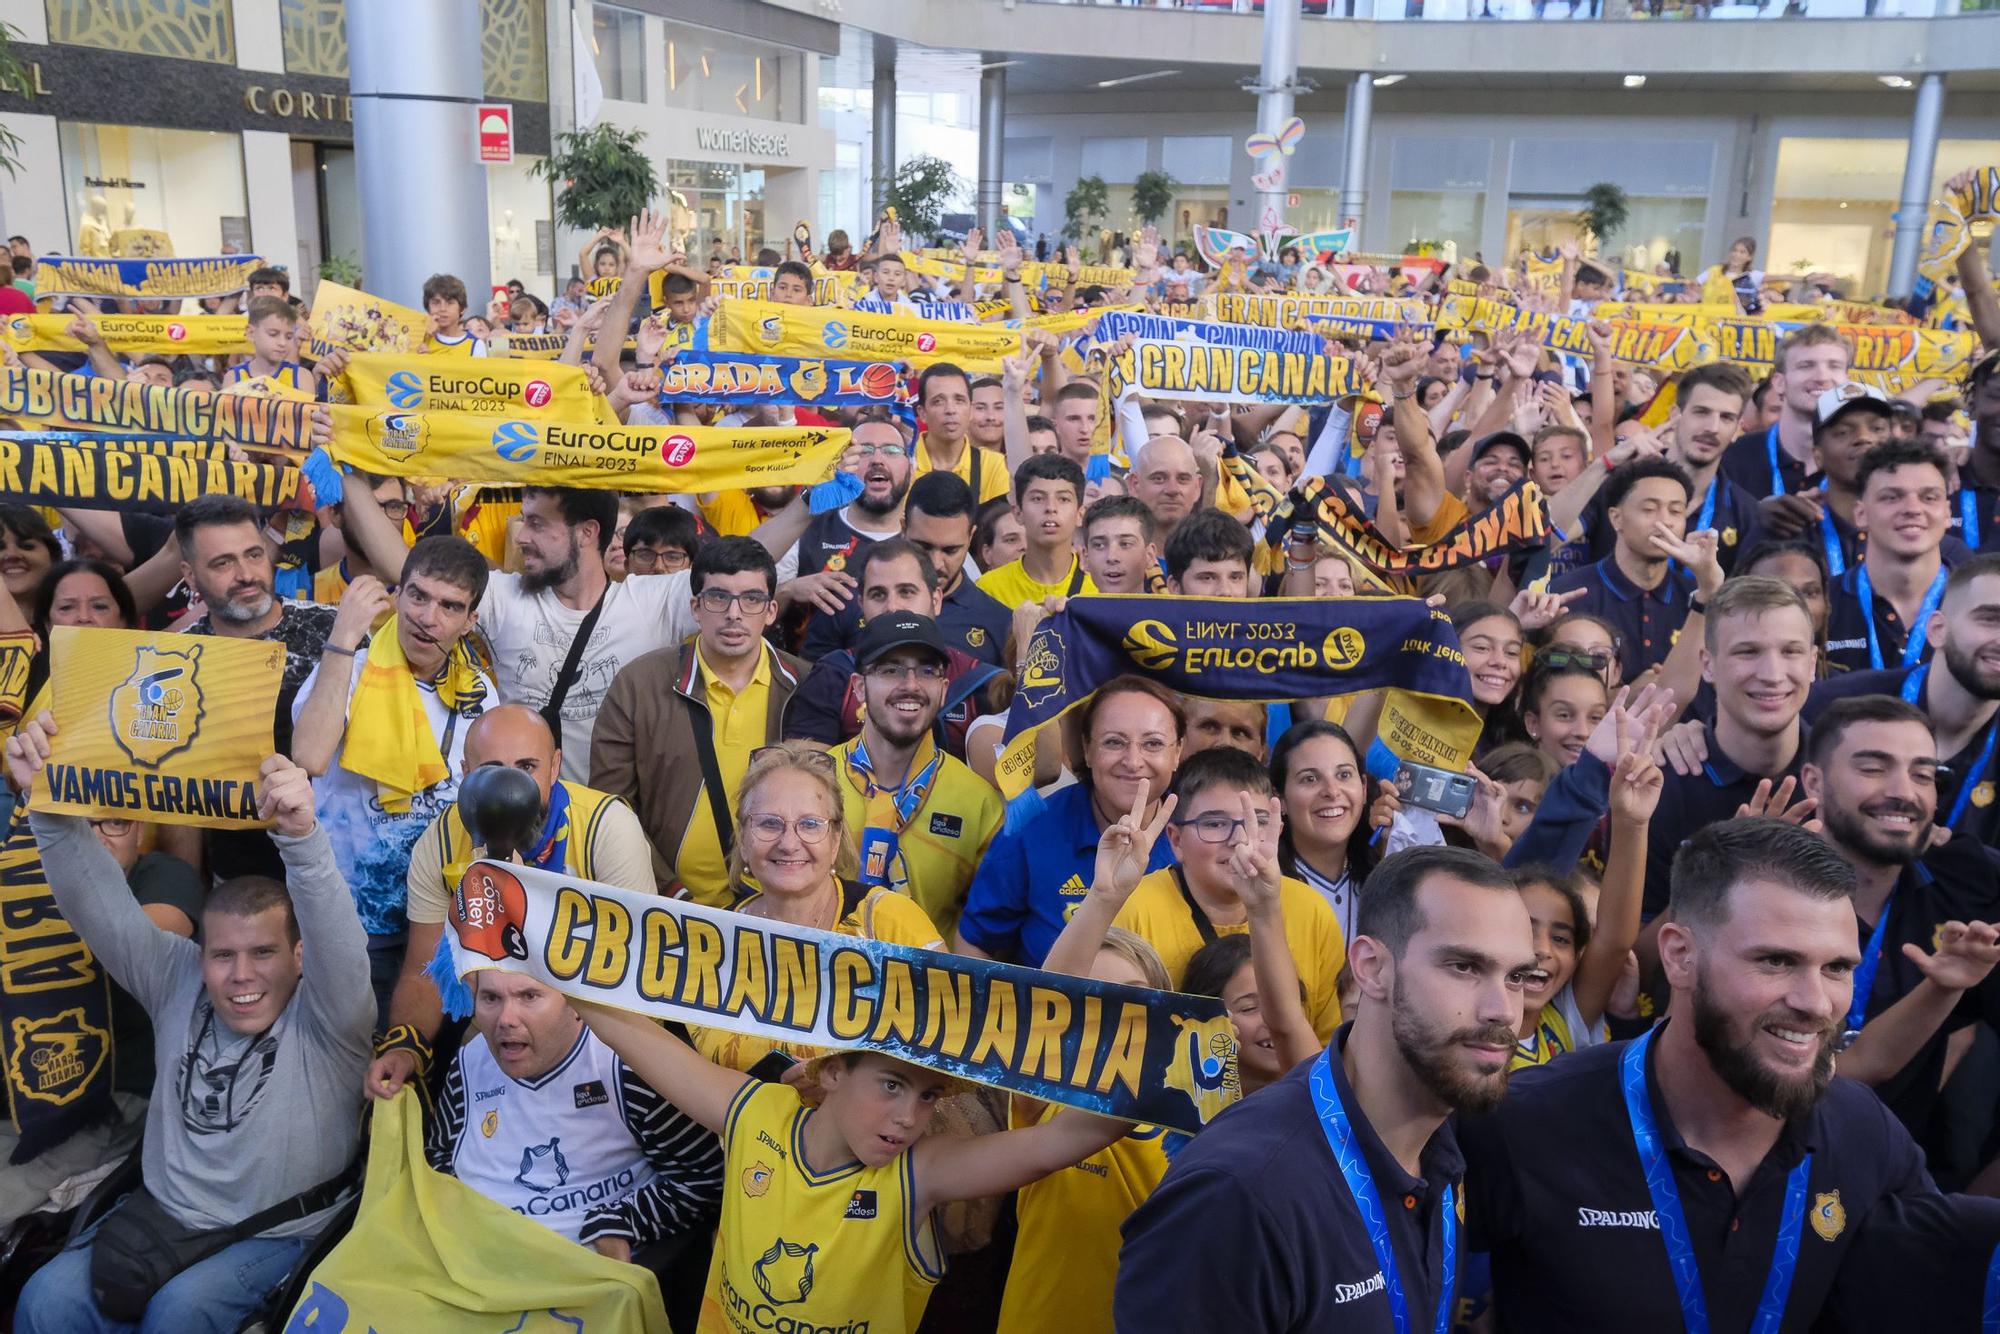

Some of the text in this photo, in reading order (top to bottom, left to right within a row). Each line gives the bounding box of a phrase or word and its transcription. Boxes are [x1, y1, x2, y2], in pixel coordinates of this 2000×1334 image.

[101, 320, 164, 334] EuroCup
[852, 325, 915, 346] EuroCup
[662, 361, 786, 396] GRADA
[1140, 343, 1234, 394] GRAN
[429, 375, 521, 399] EuroCup
[60, 373, 178, 433] GRAN
[428, 399, 505, 412] FINAL 2023
[546, 427, 657, 457] EuroCup
[731, 439, 807, 449] Türk Telekom
[544, 452, 637, 472] FINAL 2023
[104, 450, 300, 507] CANARIA
[138, 703, 168, 721] GRAN
[130, 720, 178, 741] CANARIA
[1418, 731, 1458, 764] CANARIA
[46, 763, 262, 821] VAMOS GRANCA
[468, 897, 484, 929] Rey
[482, 875, 495, 926] Copa
[543, 886, 633, 990] CB
[636, 906, 822, 1033] GRAN
[827, 947, 1150, 1100] CANARIA
[1578, 1206, 1660, 1230] SPALDING
[1335, 1271, 1386, 1304] SPALDIN
